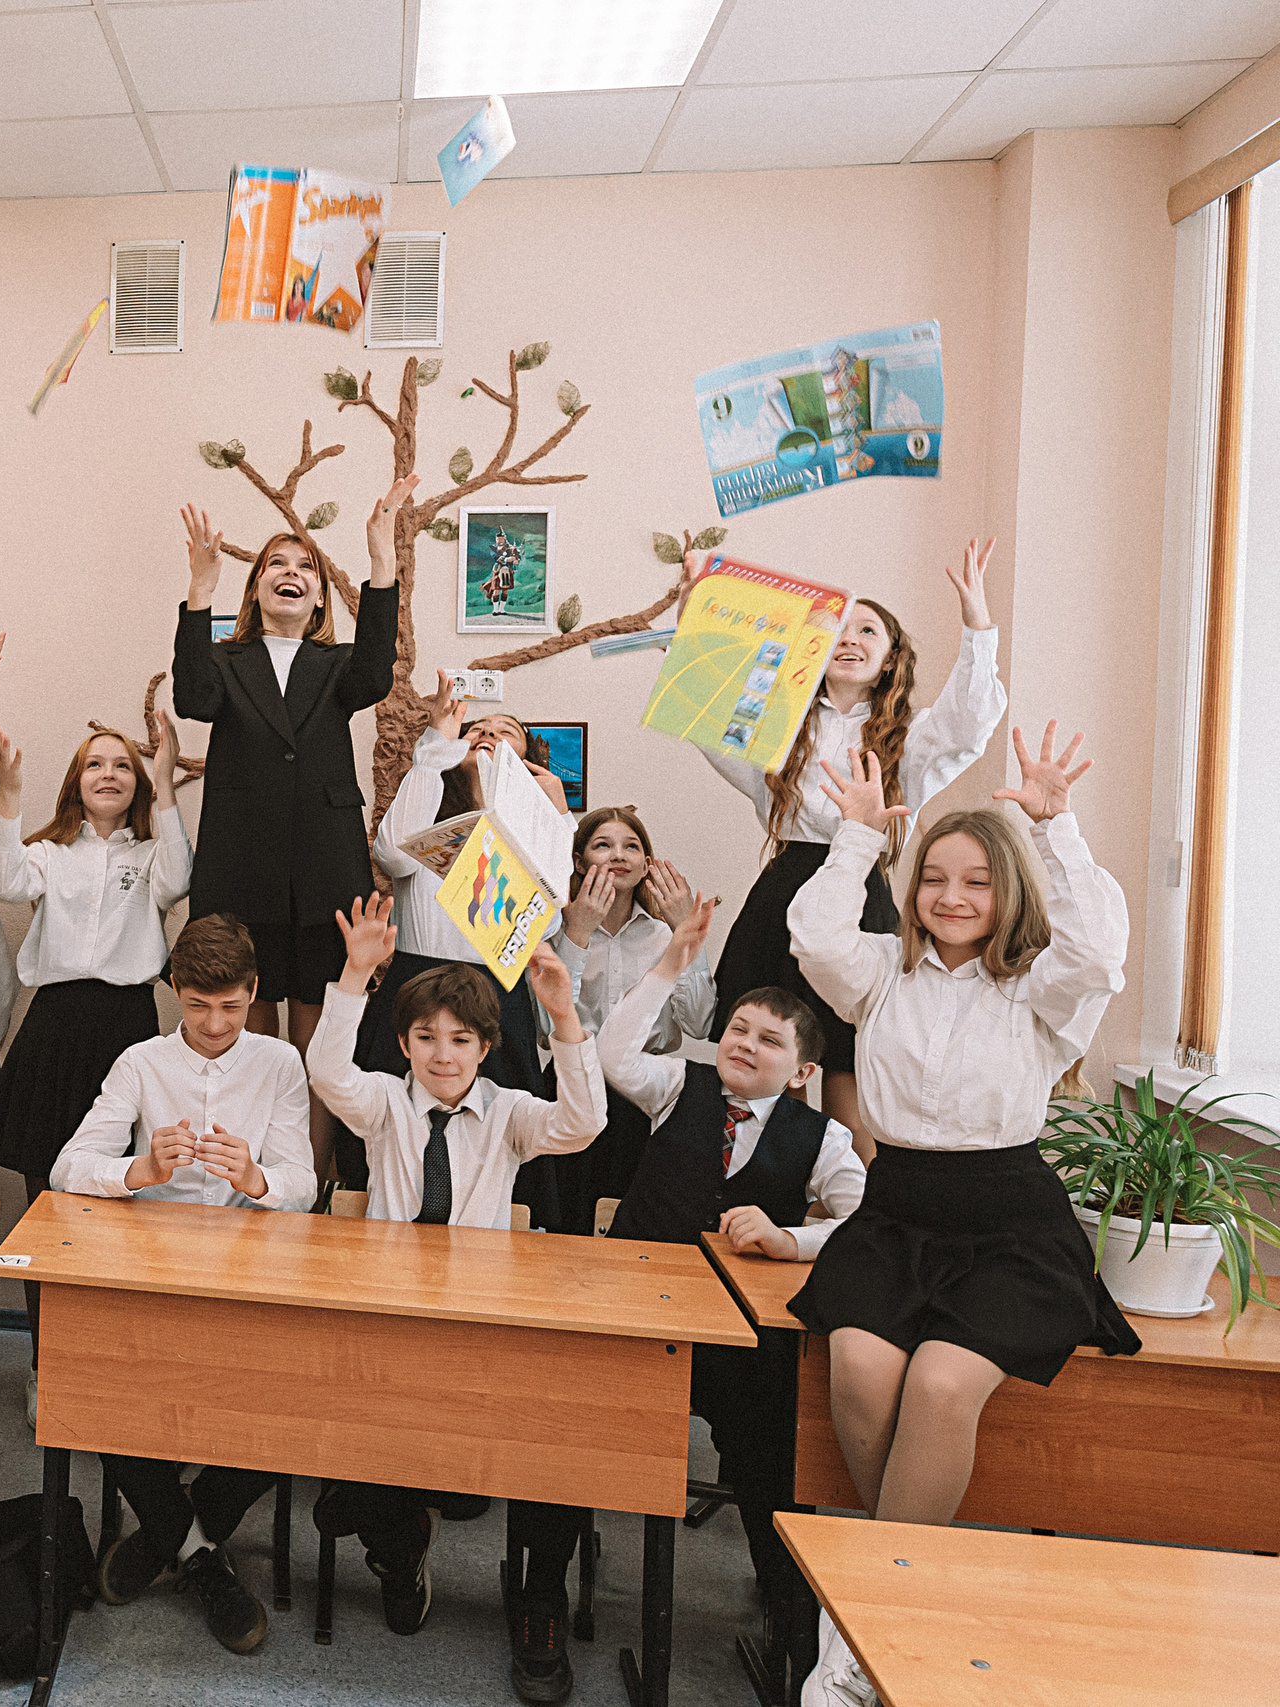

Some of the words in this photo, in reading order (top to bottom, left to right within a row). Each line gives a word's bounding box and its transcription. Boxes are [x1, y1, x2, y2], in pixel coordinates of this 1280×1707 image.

[701, 596, 788, 636] География
[806, 634, 824, 656] 5
[790, 665, 809, 687] 6
[498, 891, 548, 967] English
